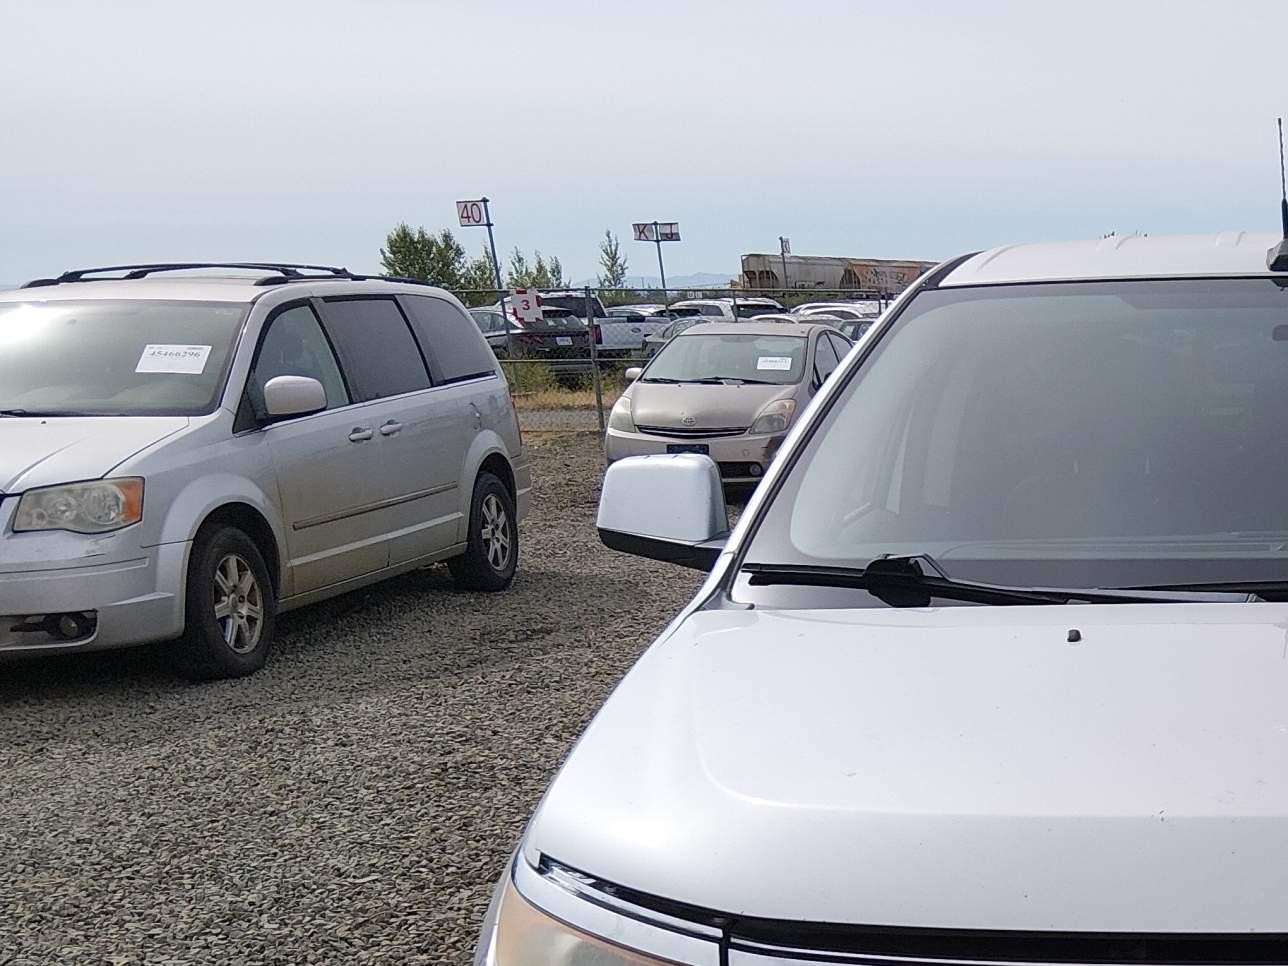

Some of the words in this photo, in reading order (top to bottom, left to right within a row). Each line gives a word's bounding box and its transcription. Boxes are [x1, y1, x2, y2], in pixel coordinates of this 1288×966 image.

[460, 203, 482, 224] 40
[637, 225, 649, 240] K
[665, 224, 675, 240] J
[521, 299, 531, 311] 3
